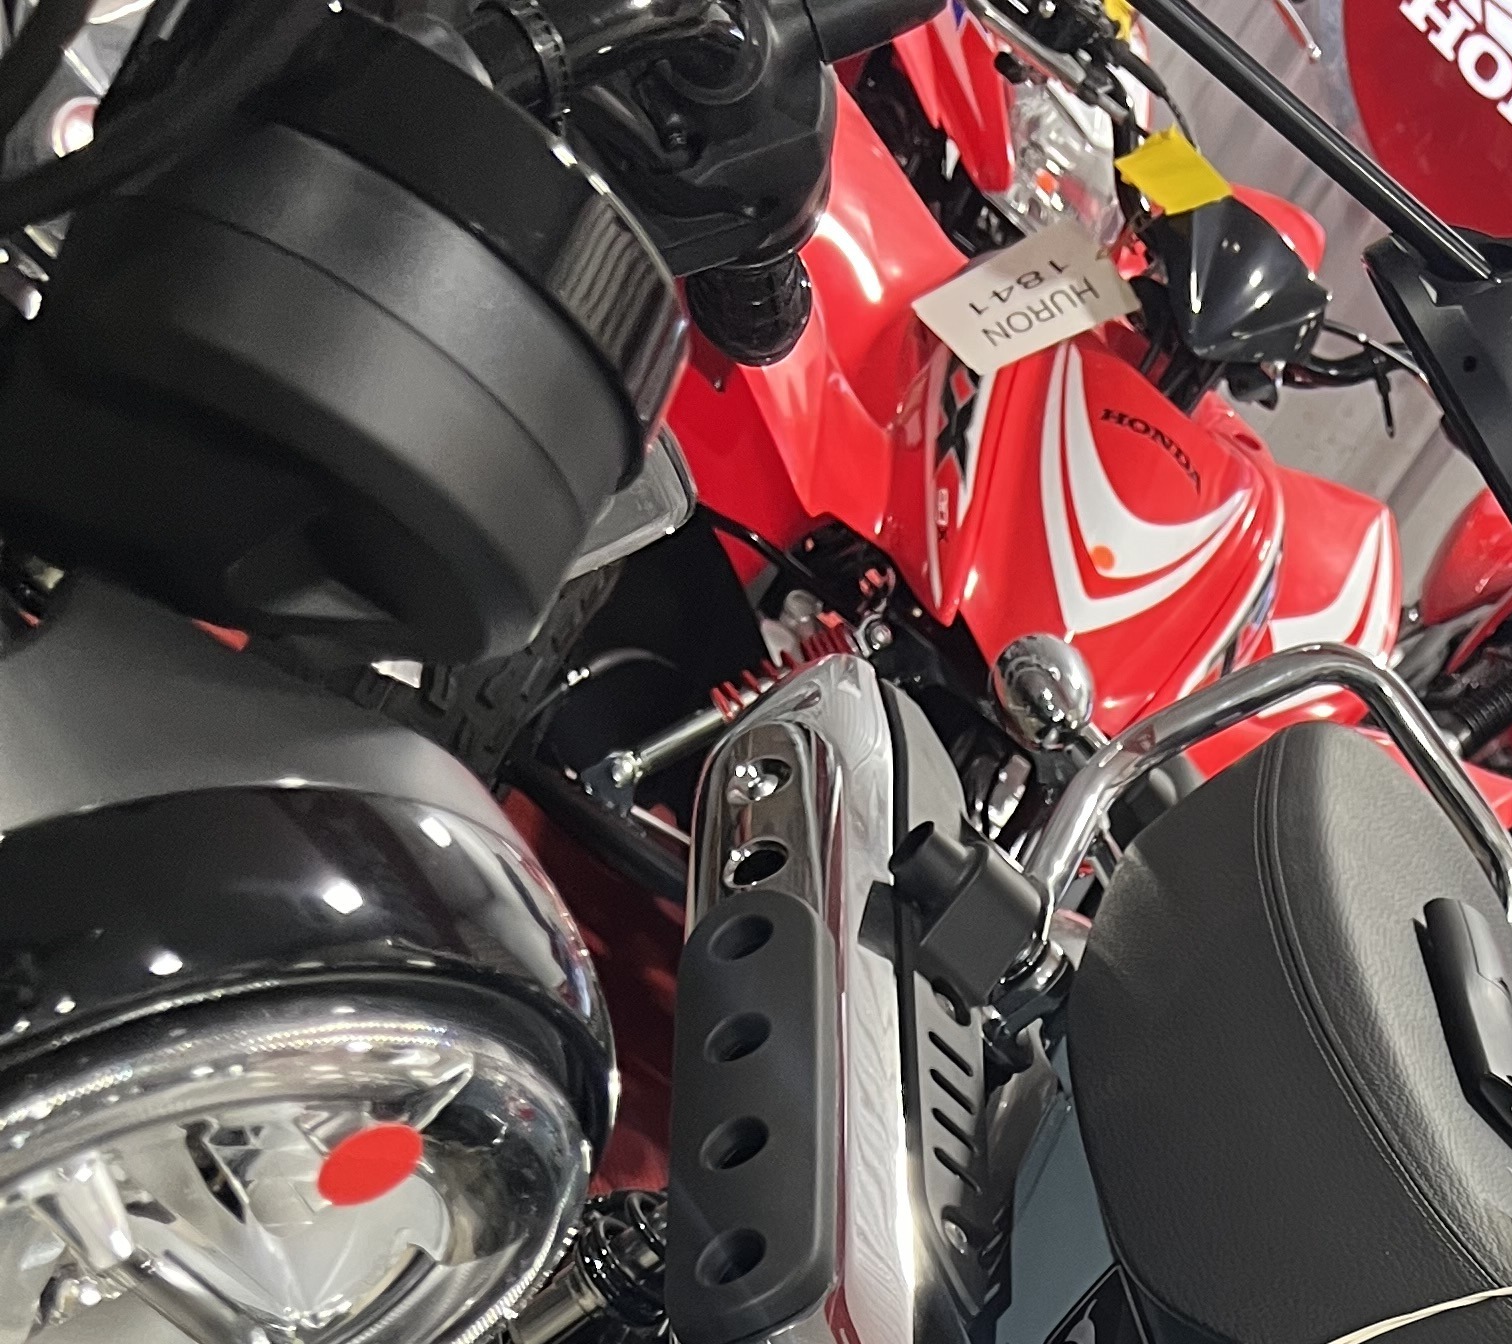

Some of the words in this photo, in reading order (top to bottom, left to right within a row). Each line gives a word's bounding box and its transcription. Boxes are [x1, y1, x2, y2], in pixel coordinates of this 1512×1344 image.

[967, 259, 1069, 316] 1841
[981, 276, 1100, 347] HURON
[1101, 408, 1200, 496] HONDA
